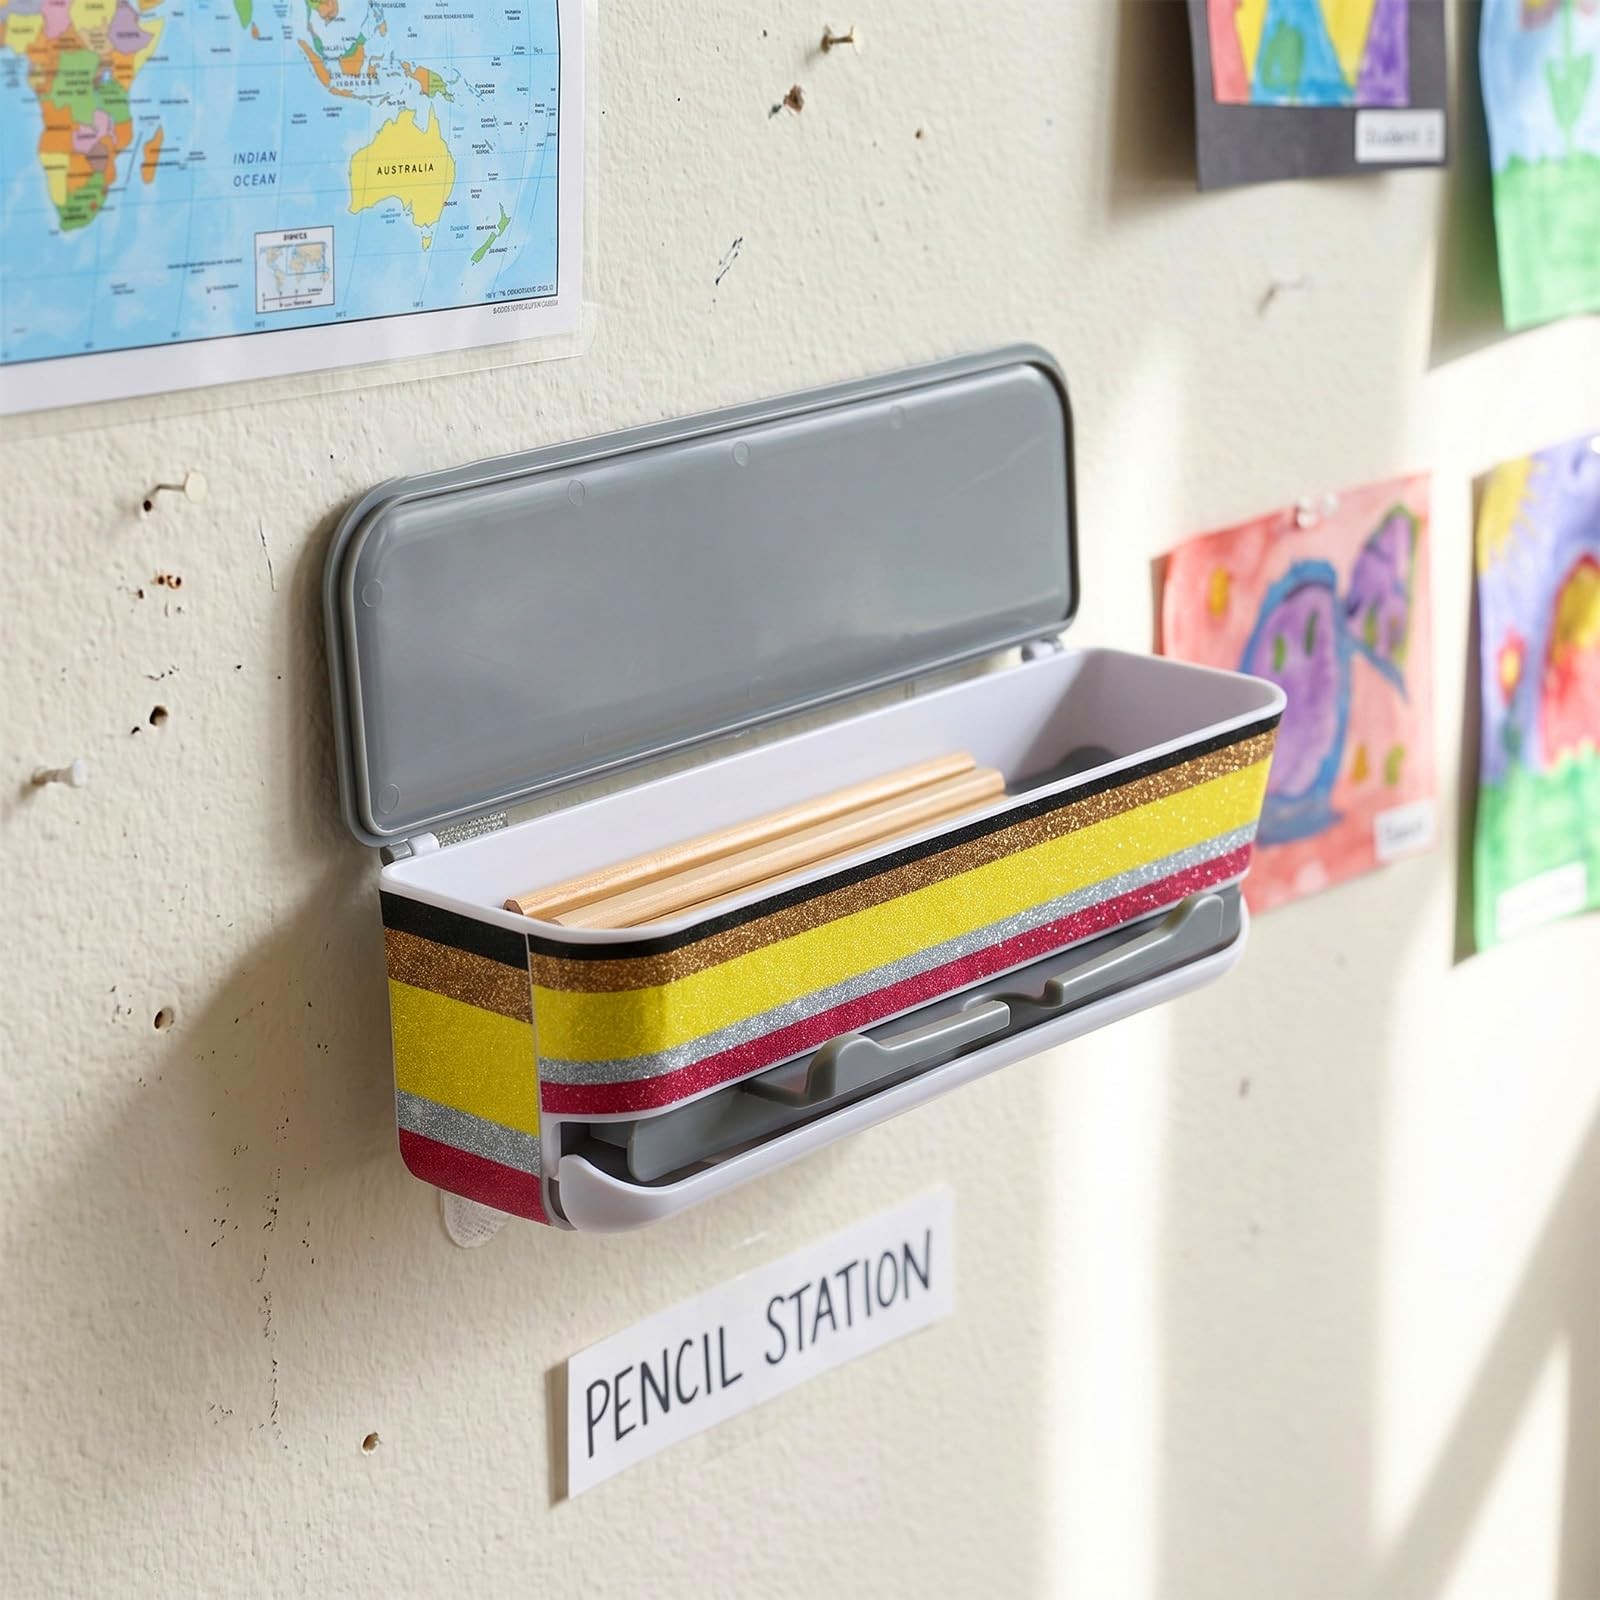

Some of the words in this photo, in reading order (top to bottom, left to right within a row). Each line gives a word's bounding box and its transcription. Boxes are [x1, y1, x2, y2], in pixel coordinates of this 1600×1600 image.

[232, 150, 278, 165] INDIAN
[376, 163, 435, 176] AUSTRALIA
[233, 173, 277, 188] OCEAN
[585, 1325, 743, 1459] PENCIL
[764, 1226, 932, 1366] STATION
